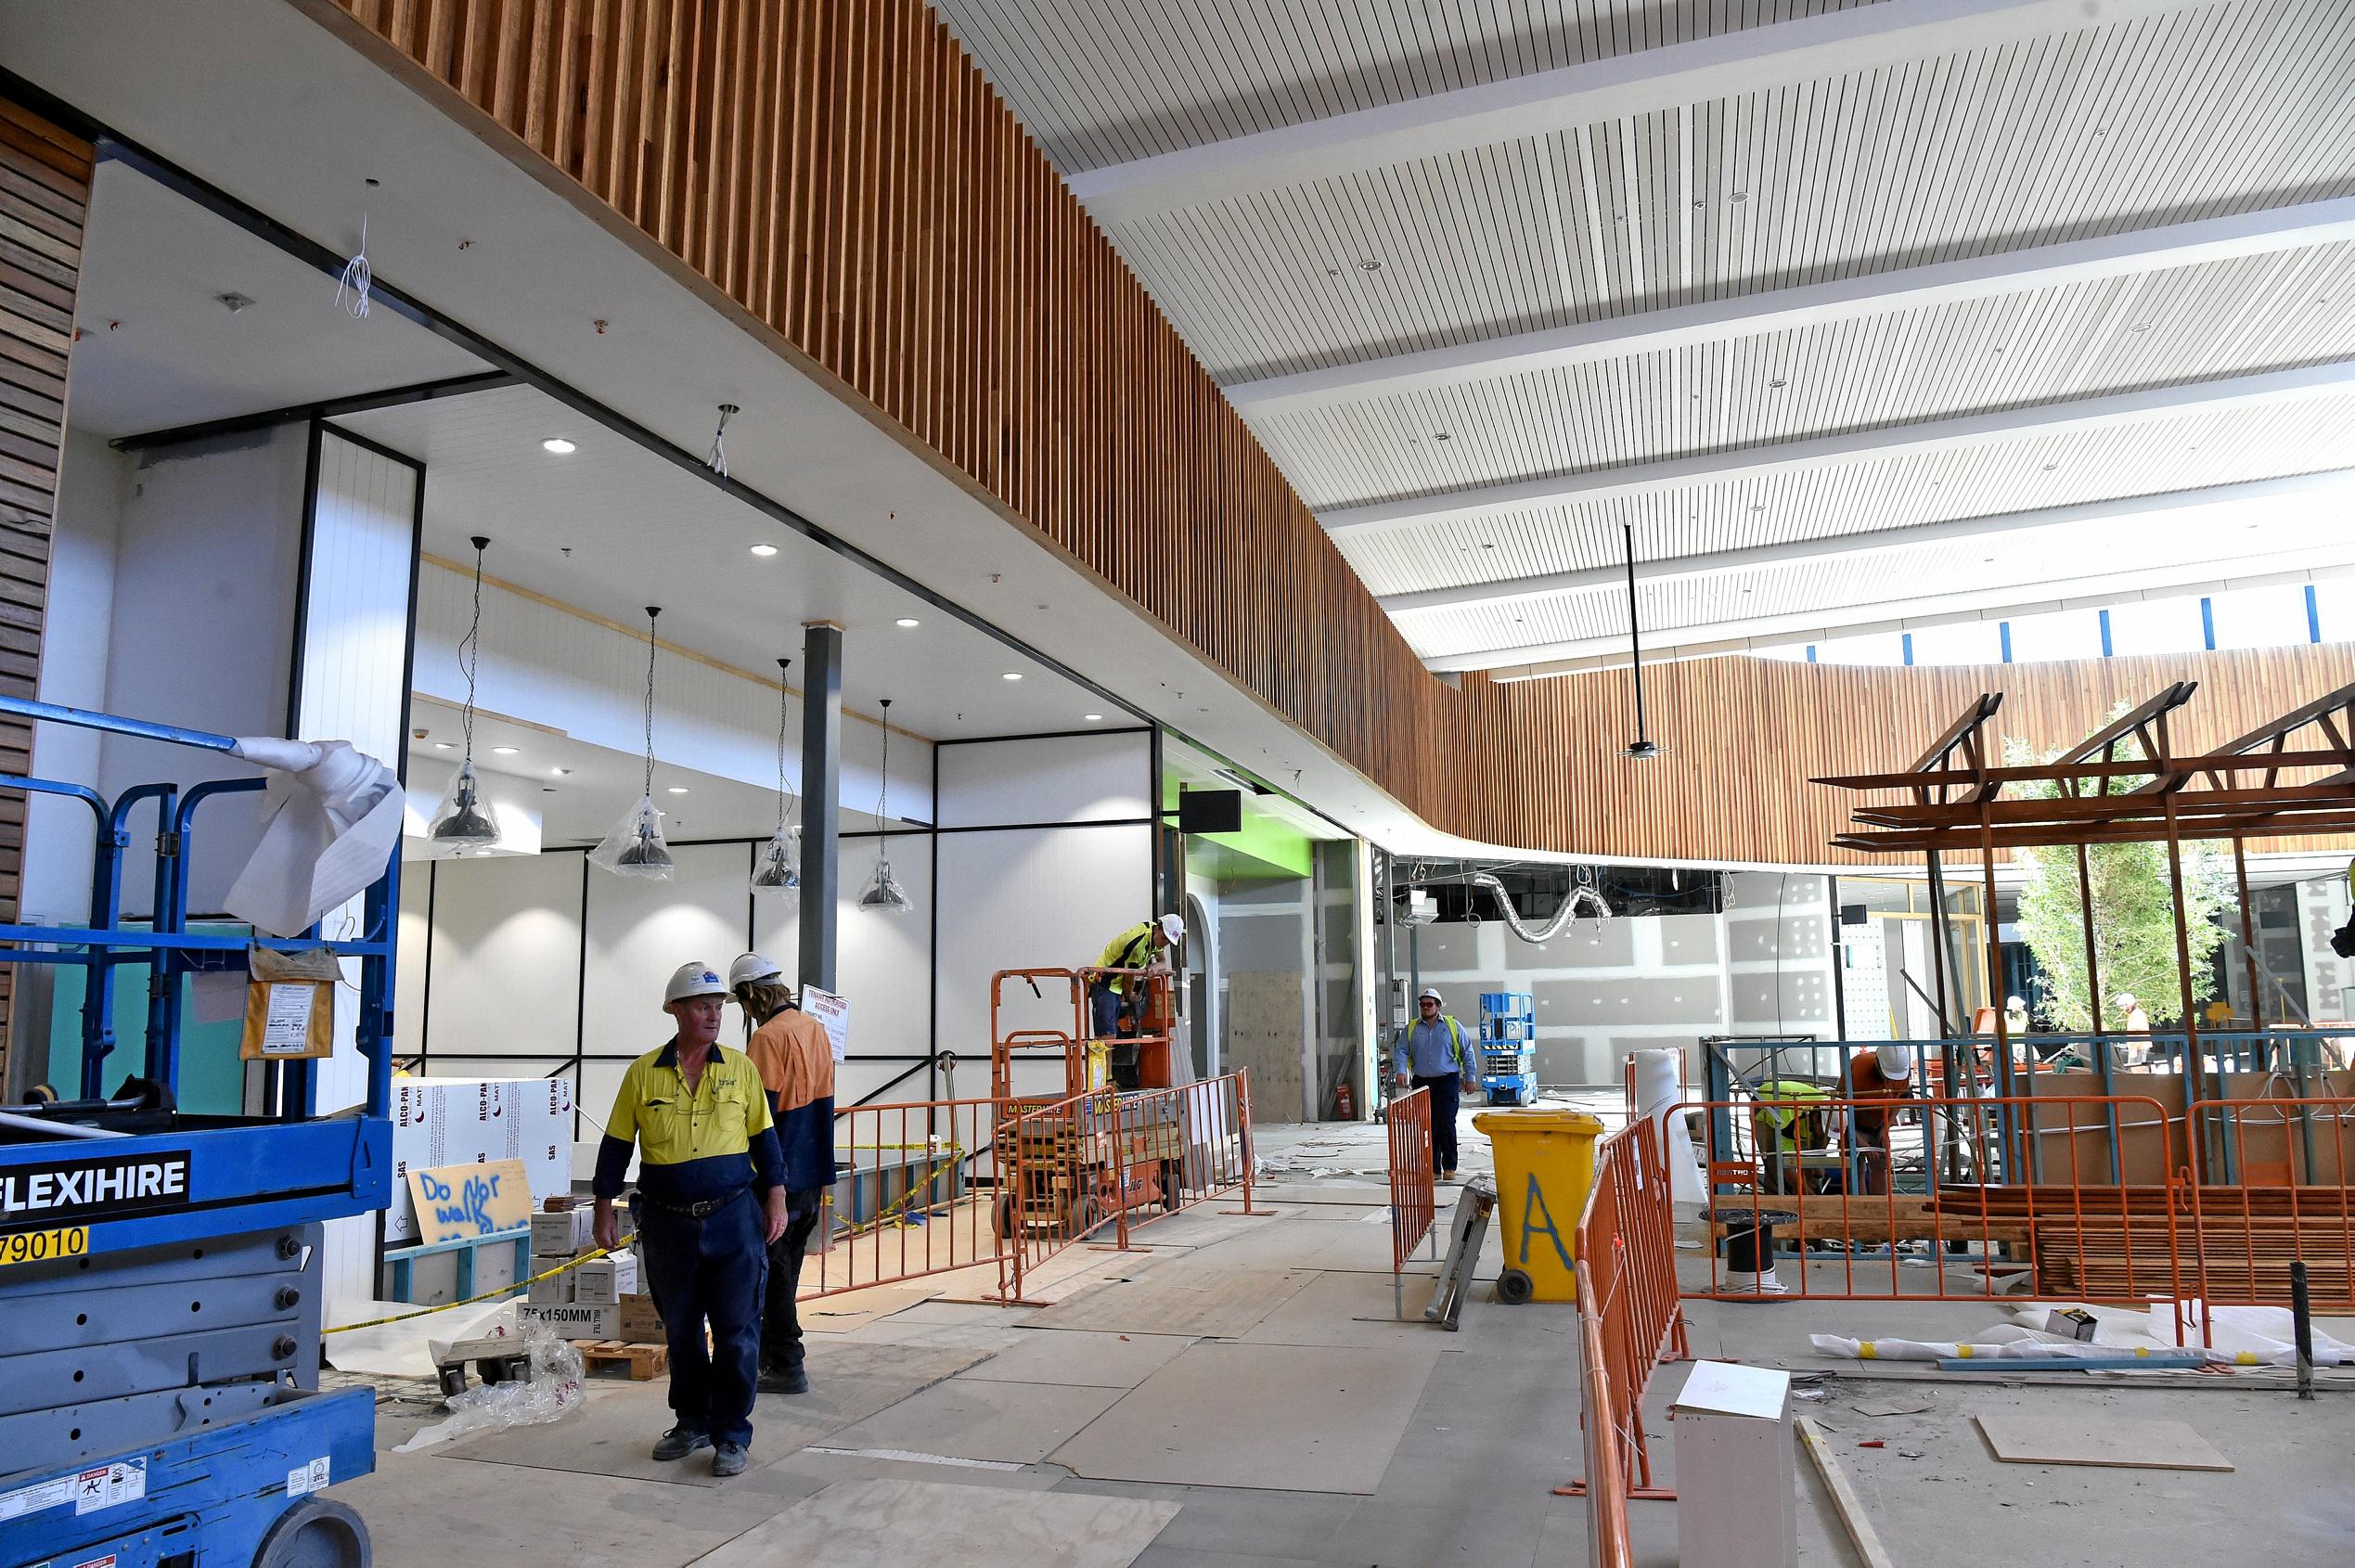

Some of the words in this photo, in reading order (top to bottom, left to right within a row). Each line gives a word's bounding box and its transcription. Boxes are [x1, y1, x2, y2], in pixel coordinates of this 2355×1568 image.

[815, 1002, 830, 1014] ACCESS
[398, 1161, 406, 1178] SAS
[0, 1161, 185, 1213] LEXIHIRE
[419, 1173, 451, 1202] Do
[1520, 1173, 1575, 1271] A
[86, 1470, 107, 1479] DANGER
